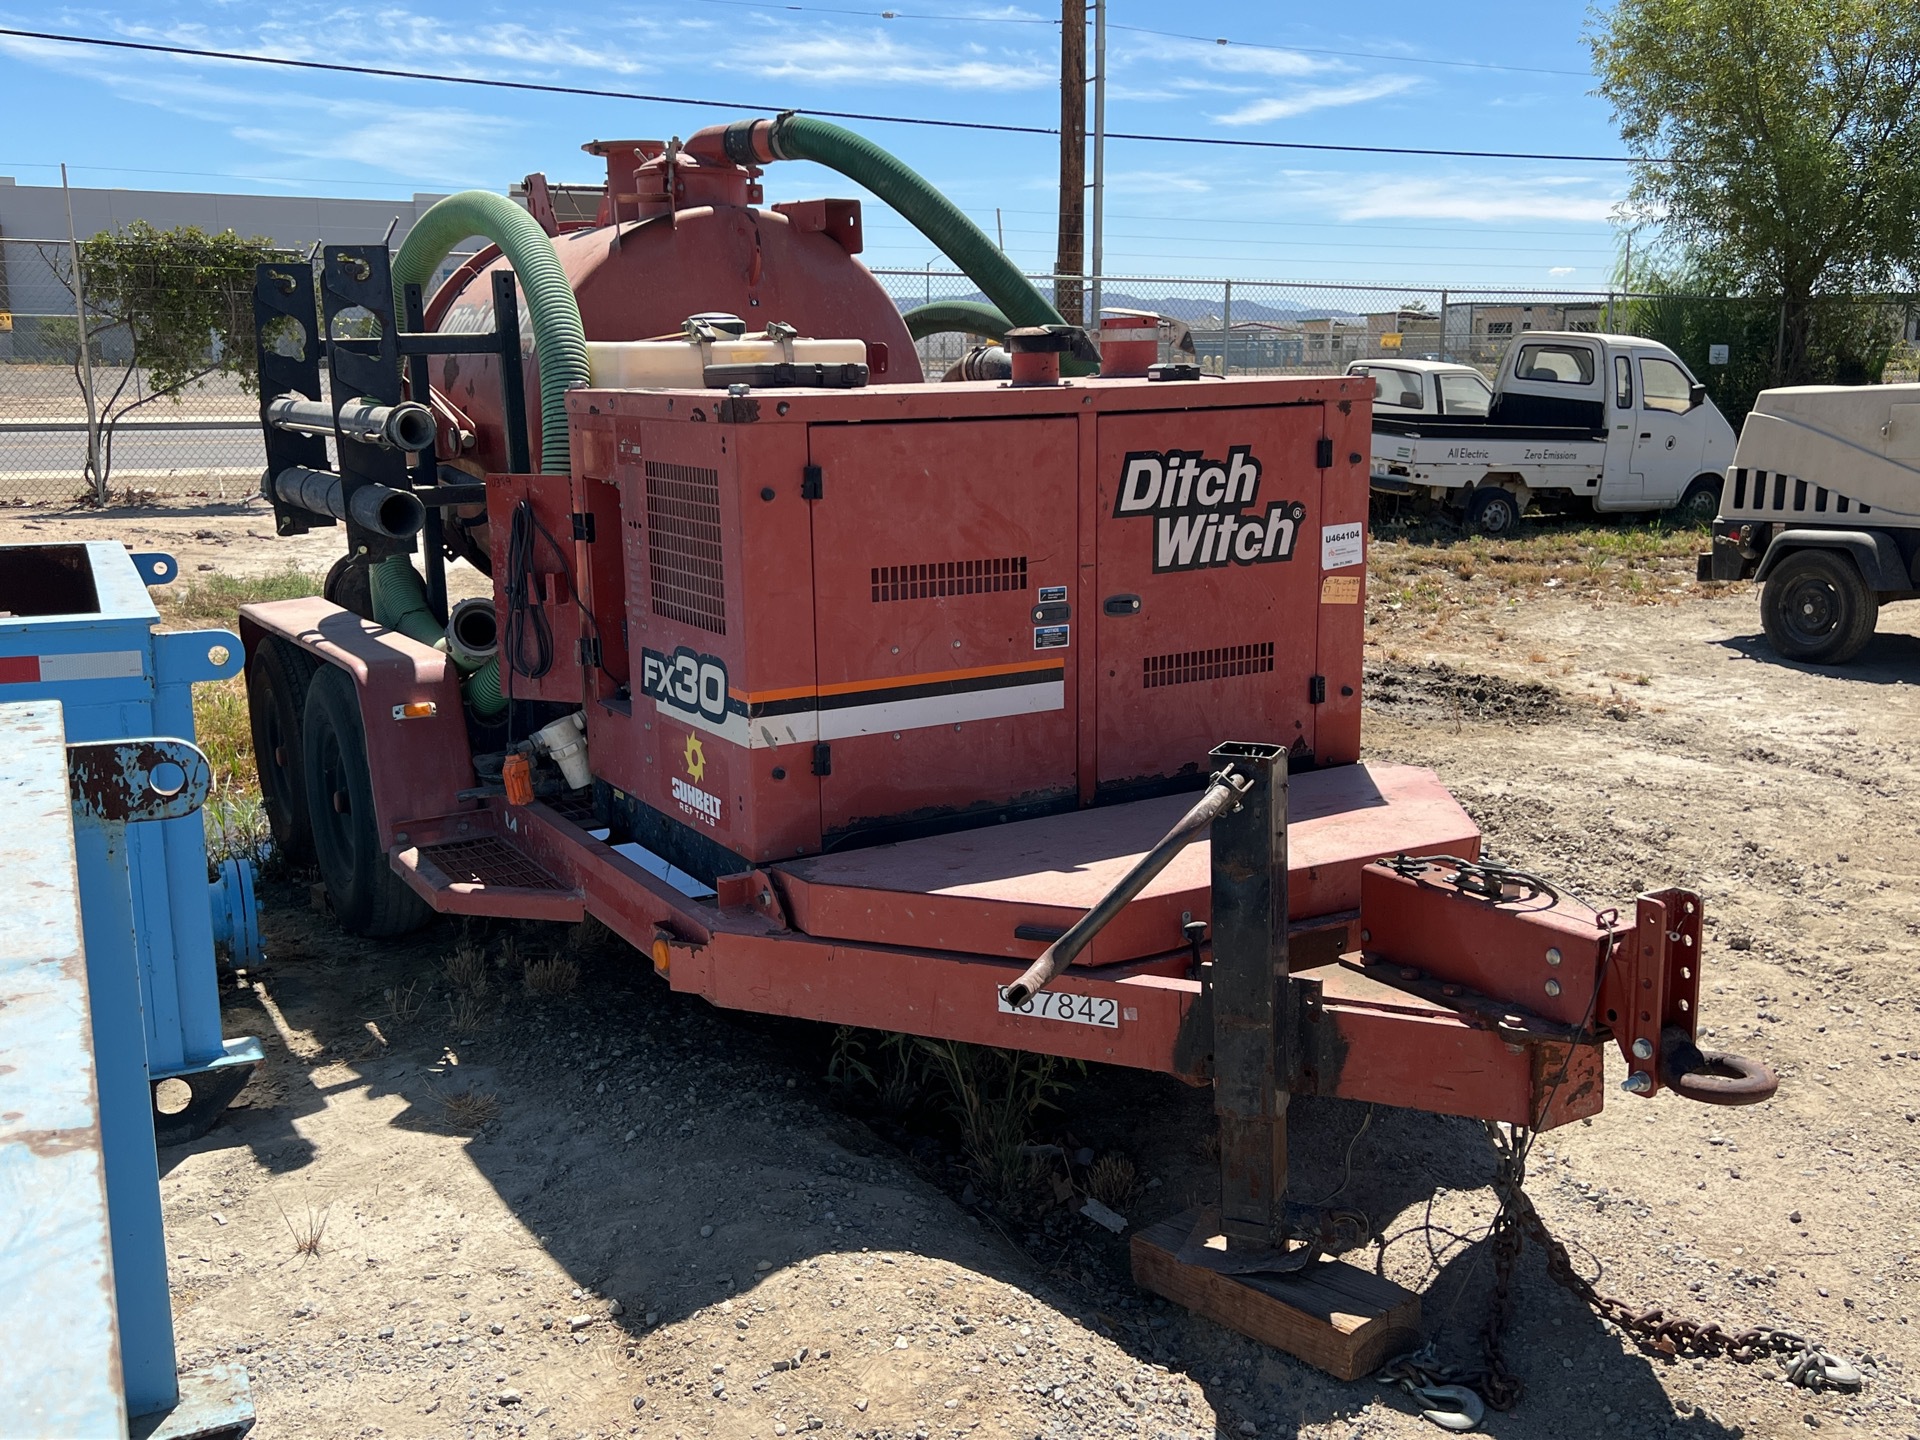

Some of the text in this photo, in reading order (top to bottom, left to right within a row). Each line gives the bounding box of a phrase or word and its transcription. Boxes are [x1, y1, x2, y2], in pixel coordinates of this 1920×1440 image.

[1448, 448, 1577, 460] All Electric Zero Emissions
[1120, 453, 1257, 511] Ditch
[1325, 530, 1360, 543] U464104
[644, 655, 725, 715] FX30
[672, 776, 721, 820] SUNBELT
